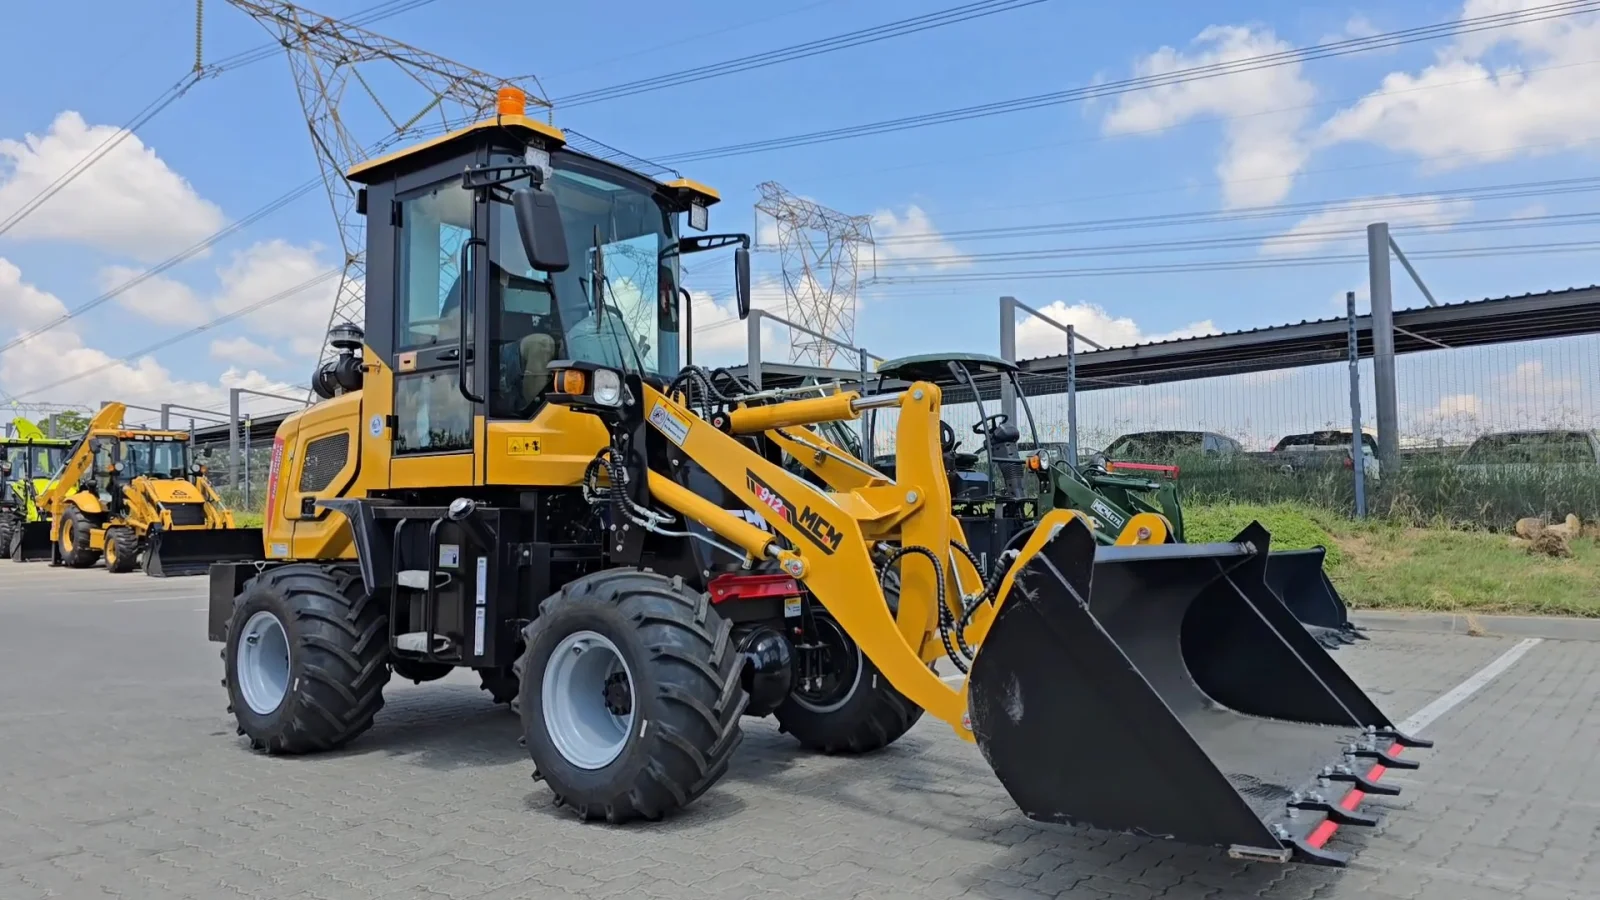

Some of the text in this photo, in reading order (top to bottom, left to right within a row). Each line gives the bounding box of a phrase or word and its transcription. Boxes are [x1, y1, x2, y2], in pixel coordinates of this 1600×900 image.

[759, 487, 784, 513] 912
[1093, 501, 1113, 519] MCM
[799, 505, 844, 551] MCM
